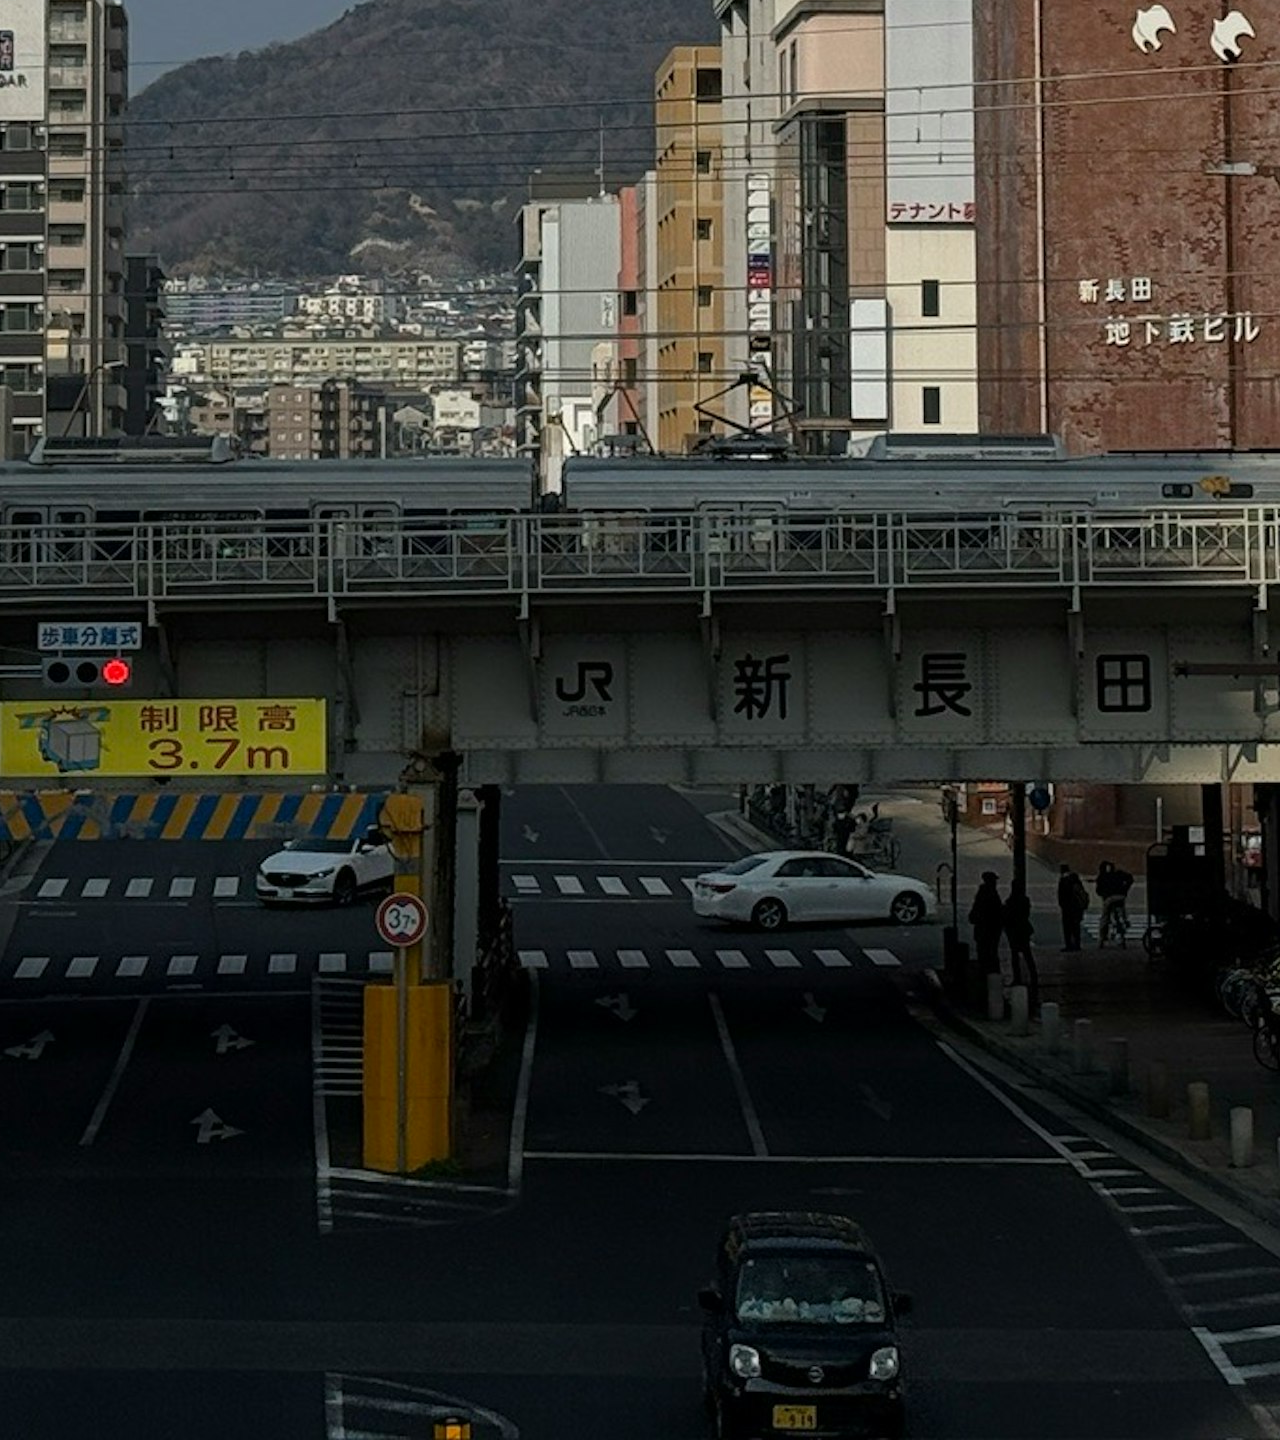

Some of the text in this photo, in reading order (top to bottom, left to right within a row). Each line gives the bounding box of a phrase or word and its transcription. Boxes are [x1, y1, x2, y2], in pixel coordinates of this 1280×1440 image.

[1078, 278, 1152, 303] 新長田
[1105, 312, 1260, 346] 地下鉄ビル
[41, 627, 138, 647] 歩車分離式
[556, 661, 614, 701] JR
[140, 705, 296, 733] 制限高
[148, 738, 289, 769] 3.7m
